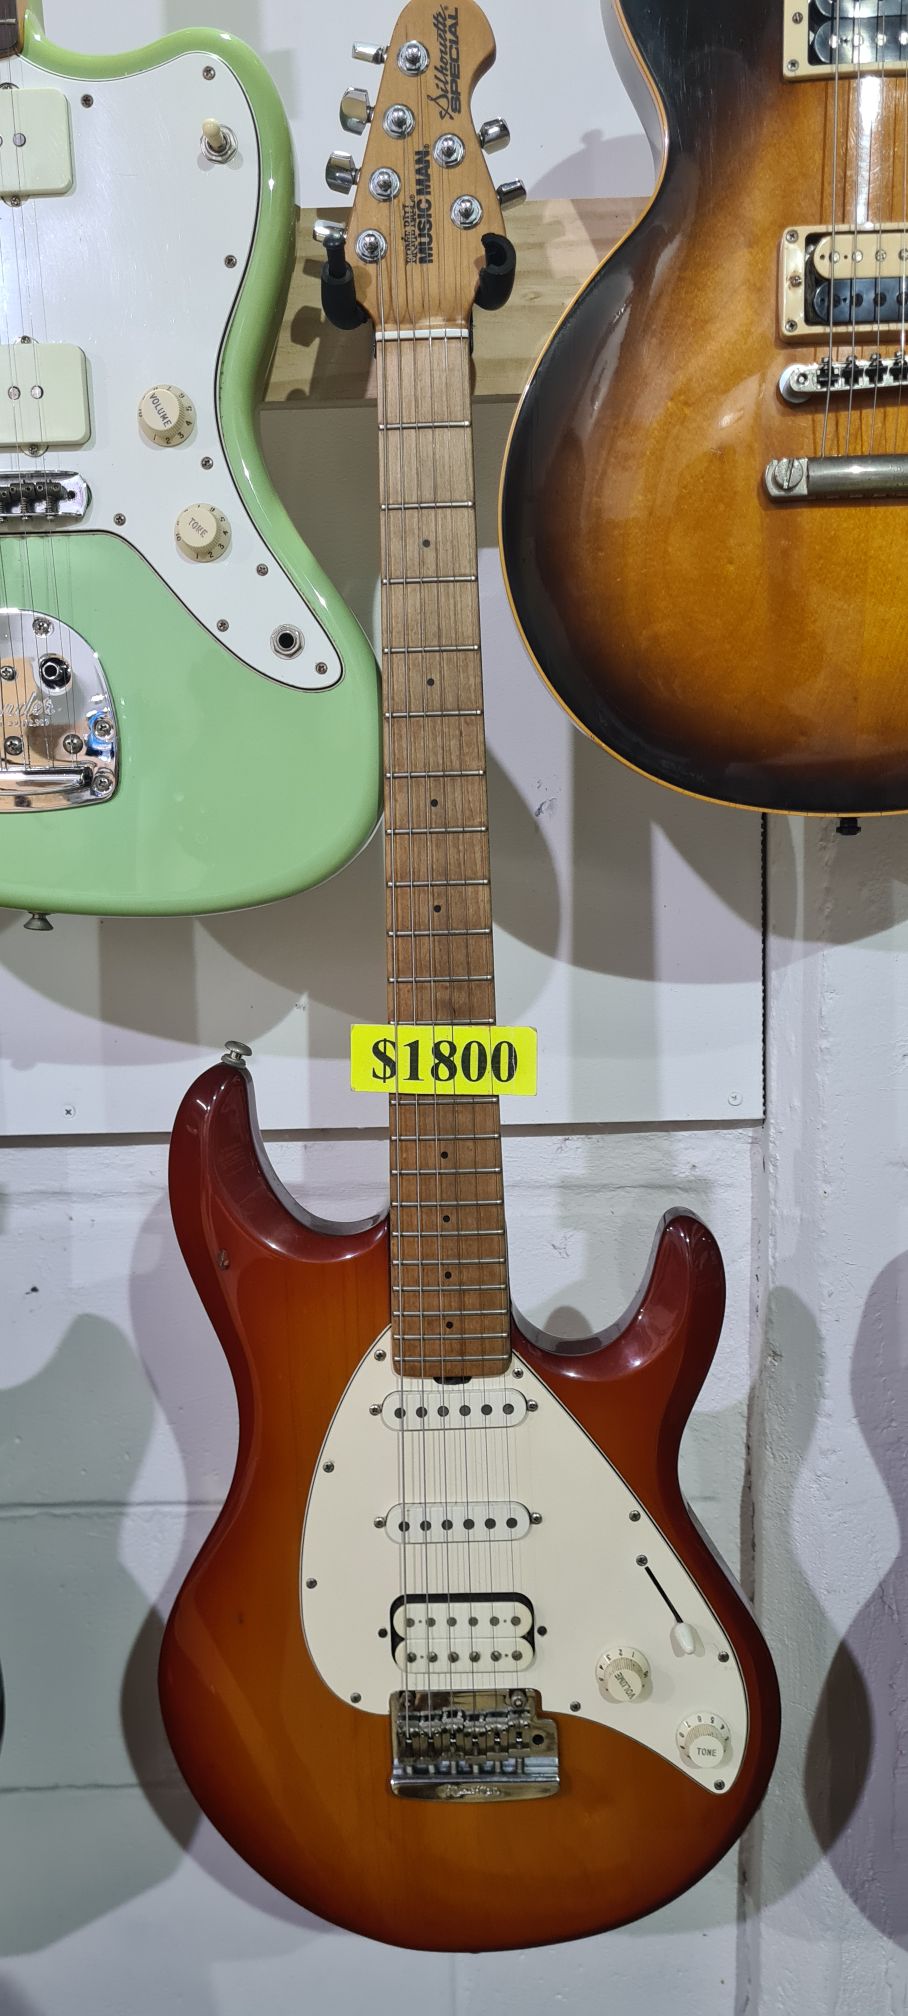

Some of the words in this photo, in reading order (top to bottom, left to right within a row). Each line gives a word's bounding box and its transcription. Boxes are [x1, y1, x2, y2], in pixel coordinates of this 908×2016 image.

[427, 4, 454, 120] Silhouette
[448, 7, 461, 114] SPECIAL
[415, 150, 431, 195] MAN
[416, 199, 433, 264] MUSIC
[150, 393, 172, 428] VOLUME
[189, 517, 208, 538] TONE
[372, 1038, 518, 1083] $1800
[614, 1671, 636, 1700] VOLUME
[697, 1747, 717, 1757] TONE
